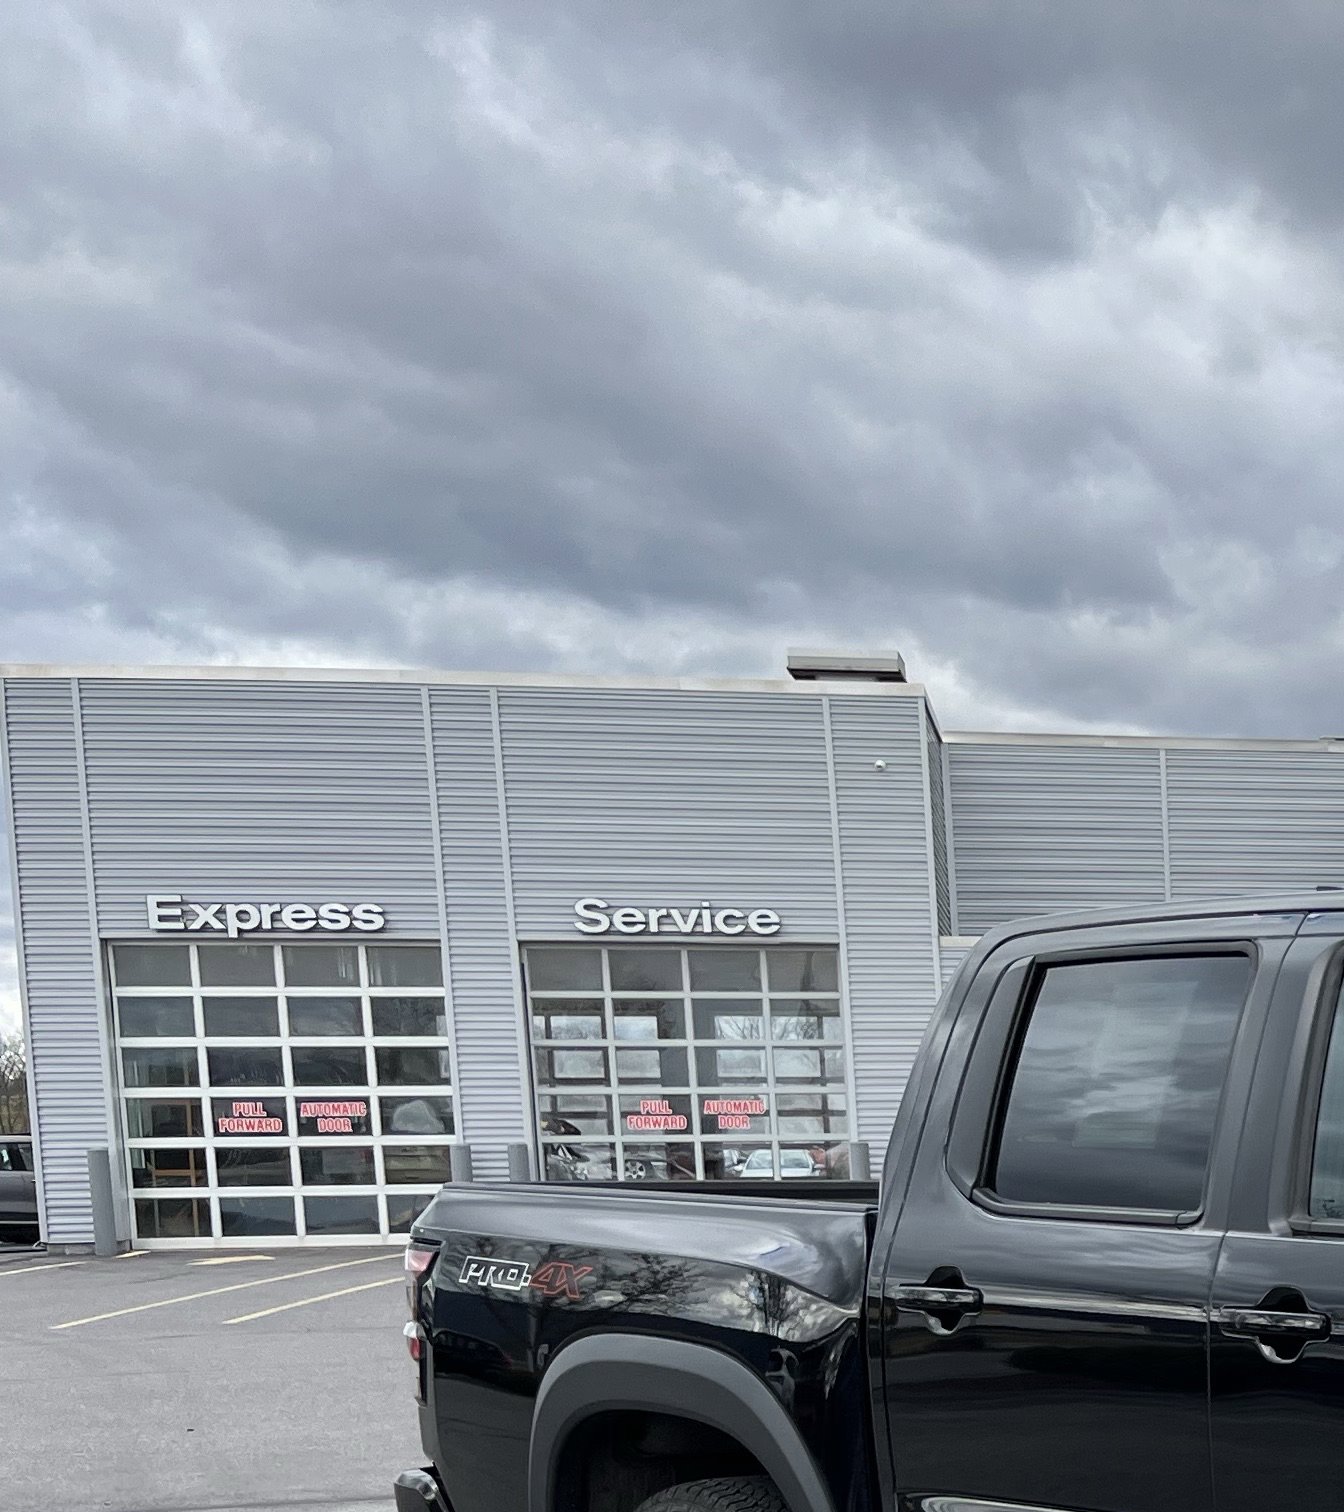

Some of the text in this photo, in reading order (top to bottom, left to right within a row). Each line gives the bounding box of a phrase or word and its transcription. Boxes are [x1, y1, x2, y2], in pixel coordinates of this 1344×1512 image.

[146, 895, 781, 938] Express Service
[232, 1102, 267, 1117] PULL
[300, 1102, 367, 1117] AUTOMATIC
[640, 1100, 672, 1115] PULL
[704, 1100, 767, 1115] AUTOMATIC
[218, 1118, 282, 1132] FORWARD
[317, 1118, 353, 1132] DOOR
[627, 1115, 687, 1130] FORWARD
[718, 1115, 751, 1129] DOOR
